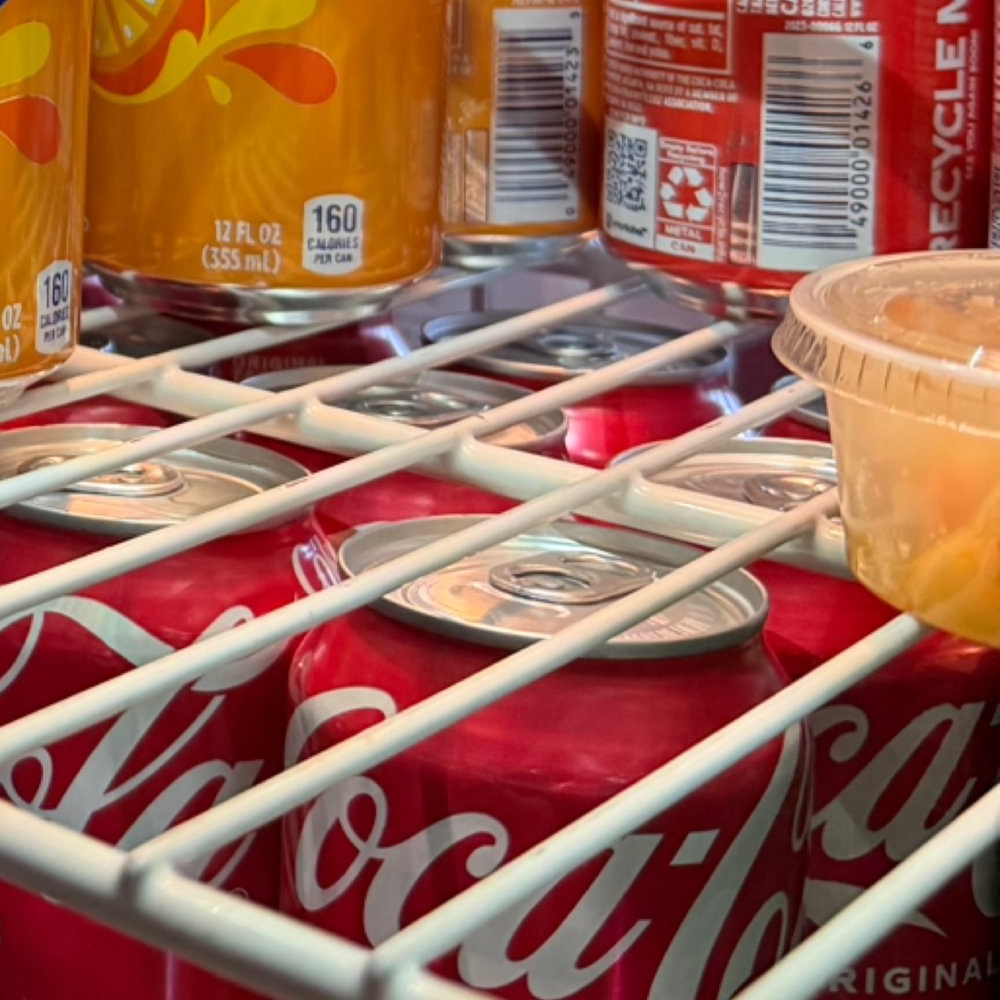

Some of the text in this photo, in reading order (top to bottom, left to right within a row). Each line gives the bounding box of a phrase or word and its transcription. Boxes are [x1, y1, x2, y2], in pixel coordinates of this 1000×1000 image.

[849, 41, 874, 228] 49000 01426 6
[929, 36, 967, 250] RECYCLE
[966, 122, 977, 151] YOU
[214, 218, 283, 247] 12 FL OZ
[312, 203, 358, 234] 160
[307, 235, 360, 251] CALORIES
[202, 244, 281, 275] (355 mL)
[313, 253, 353, 266] PER CAN
[44, 268, 69, 308] 160
[1, 303, 24, 330] OZ
[828, 950, 999, 995] RIGINAL
